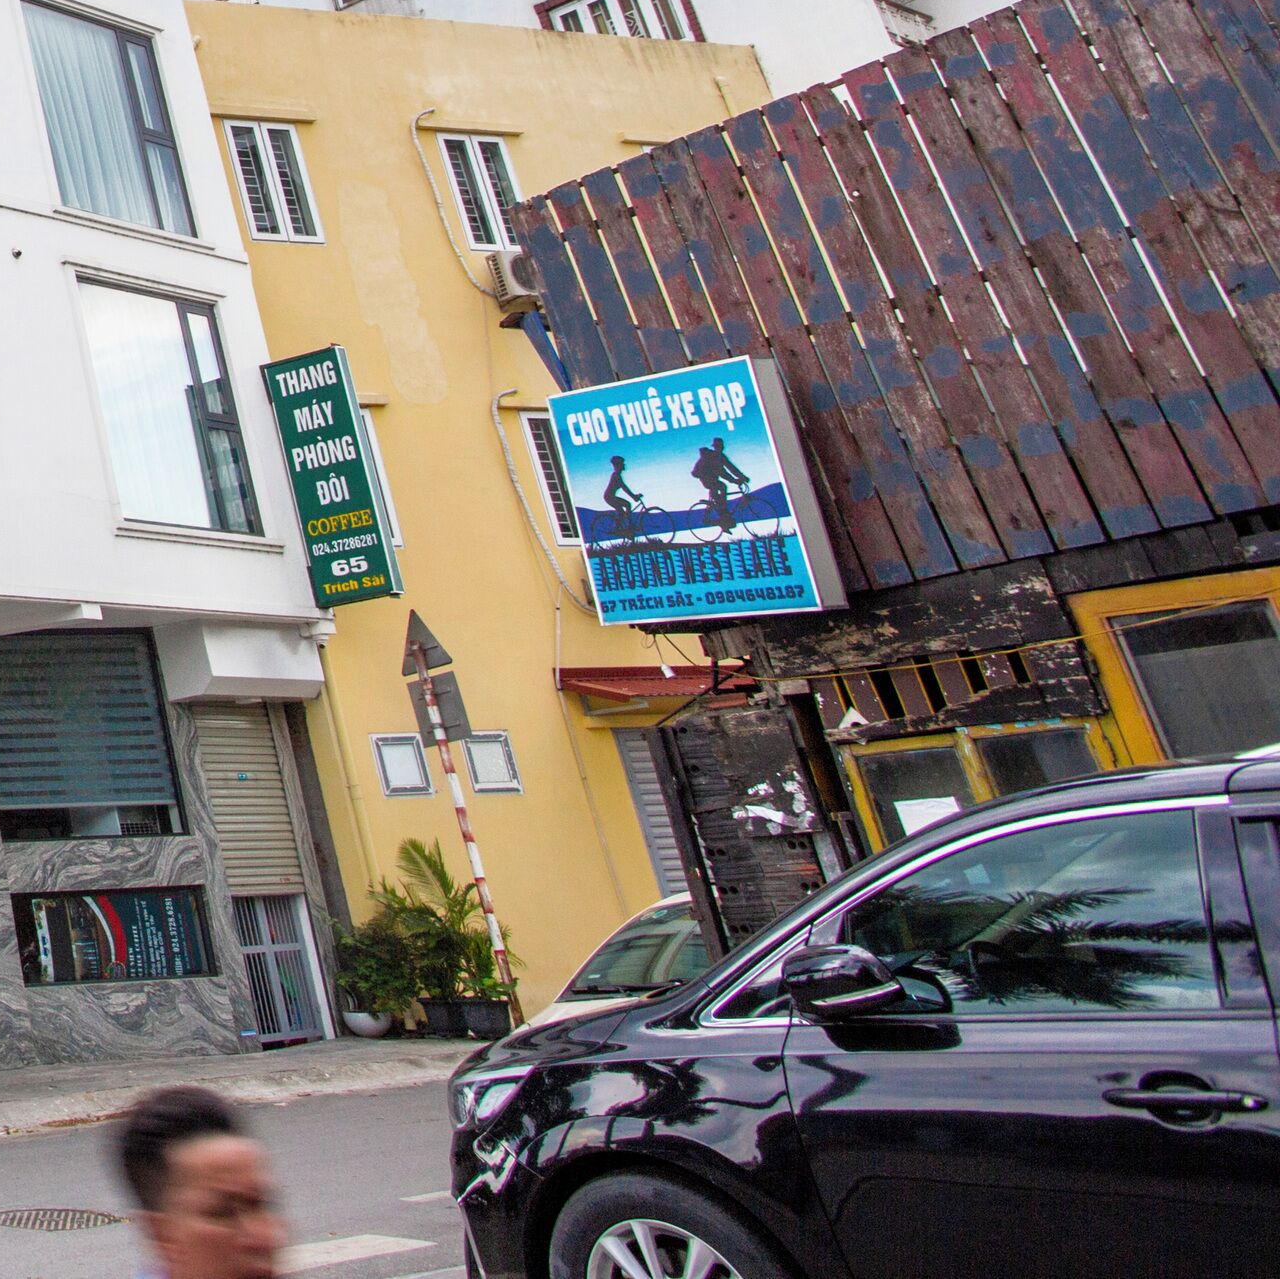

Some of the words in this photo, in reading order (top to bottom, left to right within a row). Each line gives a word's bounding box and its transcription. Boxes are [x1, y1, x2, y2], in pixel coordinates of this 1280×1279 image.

[275, 360, 337, 397] THANG
[293, 399, 334, 433] MÁY
[566, 406, 610, 446] CHO
[607, 387, 669, 439] THUÊ
[666, 390, 696, 428] XE
[698, 381, 747, 431] ĐẠP
[292, 435, 357, 472] PHÒNG
[316, 473, 350, 506] ĐÔI
[307, 508, 373, 537] COFFEE
[311, 533, 378, 558] 024.37286281
[331, 555, 369, 577] 65
[362, 574, 386, 589] Sài
[596, 548, 676, 593] AROUND
[676, 542, 734, 585] WEST
[737, 537, 793, 581] LAKE
[601, 601, 617, 613] 67
[619, 591, 665, 611] TRÍCH
[705, 584, 805, 606] 0984648187
[164, 898, 180, 952] 024.3728.6281
